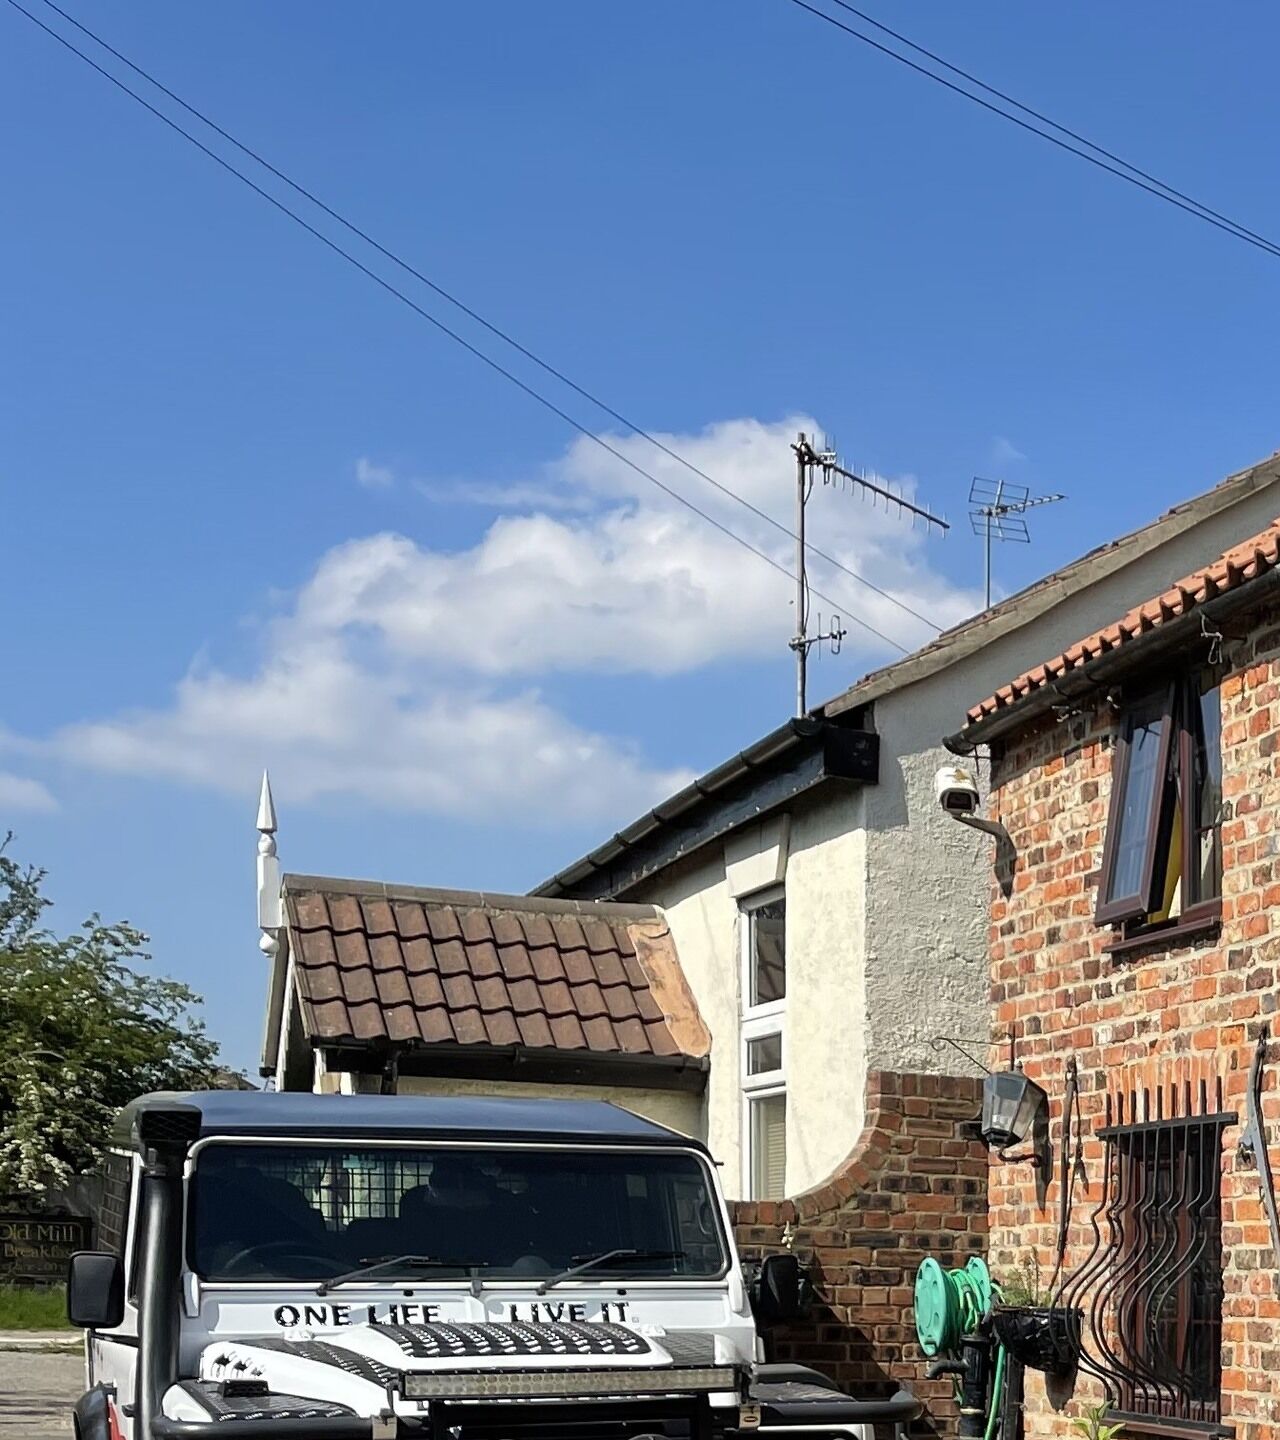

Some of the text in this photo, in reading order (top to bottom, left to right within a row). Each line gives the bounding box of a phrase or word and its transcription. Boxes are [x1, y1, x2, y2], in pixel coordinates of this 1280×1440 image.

[37, 1224, 73, 1242] Mill
[274, 1301, 630, 1327] ONE LIFE LIVE IT
